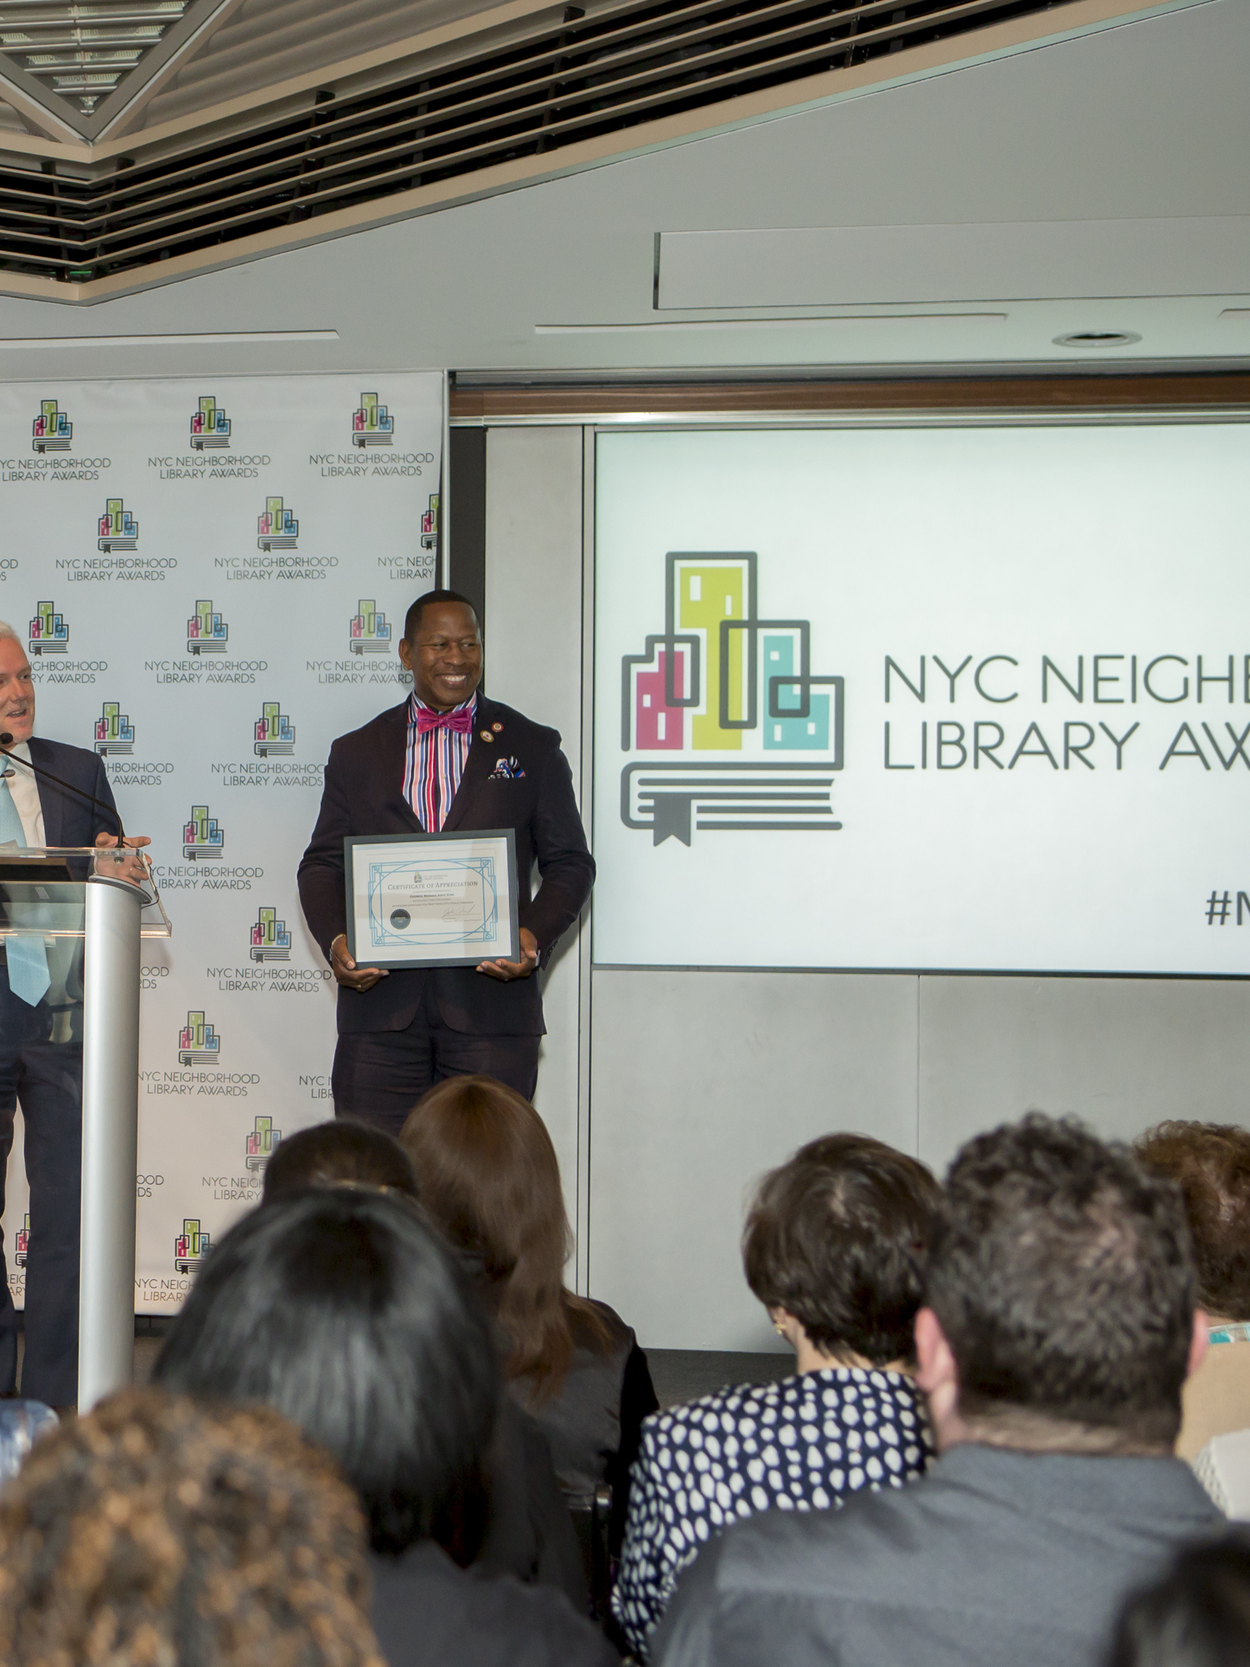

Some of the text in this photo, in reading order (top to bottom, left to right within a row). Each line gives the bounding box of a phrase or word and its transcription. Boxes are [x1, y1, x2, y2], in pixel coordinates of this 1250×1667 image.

[18, 458, 111, 469] NEIGHBORHOOD
[148, 455, 271, 467] NYC NEIGHBORHOOD
[310, 453, 434, 464] NYC NEIGHBORHOOD
[2, 470, 99, 481] LIBRARY AWARDS
[160, 468, 258, 479] LIBRARY AWARDS
[321, 466, 422, 477] LIBRARY AWARDS
[56, 558, 177, 569] NYC NEIGHBORHOOD
[215, 557, 338, 567] NYC NEIGHBORHOOD
[378, 557, 403, 567] NYC
[68, 571, 165, 581] LIBRARY AWARDS
[227, 569, 326, 580] LIBRARY AWARDS
[390, 568, 434, 579] LIBRARY
[145, 661, 268, 671] NYC NEIGHBORHOOD
[307, 661, 331, 671] NYC
[47, 674, 95, 683] AWARDS
[157, 673, 255, 683] LIBRARY AWARDS
[319, 673, 413, 684] LIBRARY AWARD
[884, 654, 1019, 703] NYC
[884, 721, 1139, 770] LIBRARY
[107, 763, 174, 773] HBORHOOD
[211, 763, 236, 773] NYC
[112, 775, 161, 785] AWARDS
[224, 776, 323, 786] LIBRARY AWARDS
[152, 866, 264, 878] YC NEIGHBORHOOD
[158, 879, 251, 890] IBRARY AWARDS
[207, 967, 333, 981] NYC NEIGHBORHOOD
[219, 981, 319, 992] LIBRARY AWARDS
[164, 1072, 260, 1085] NEIGHBORHOOD
[299, 1076, 324, 1086] NYC
[147, 1084, 247, 1096] LIBRARY AWARDS
[202, 1177, 227, 1187] NYC
[214, 1190, 262, 1201] LIBRARY
